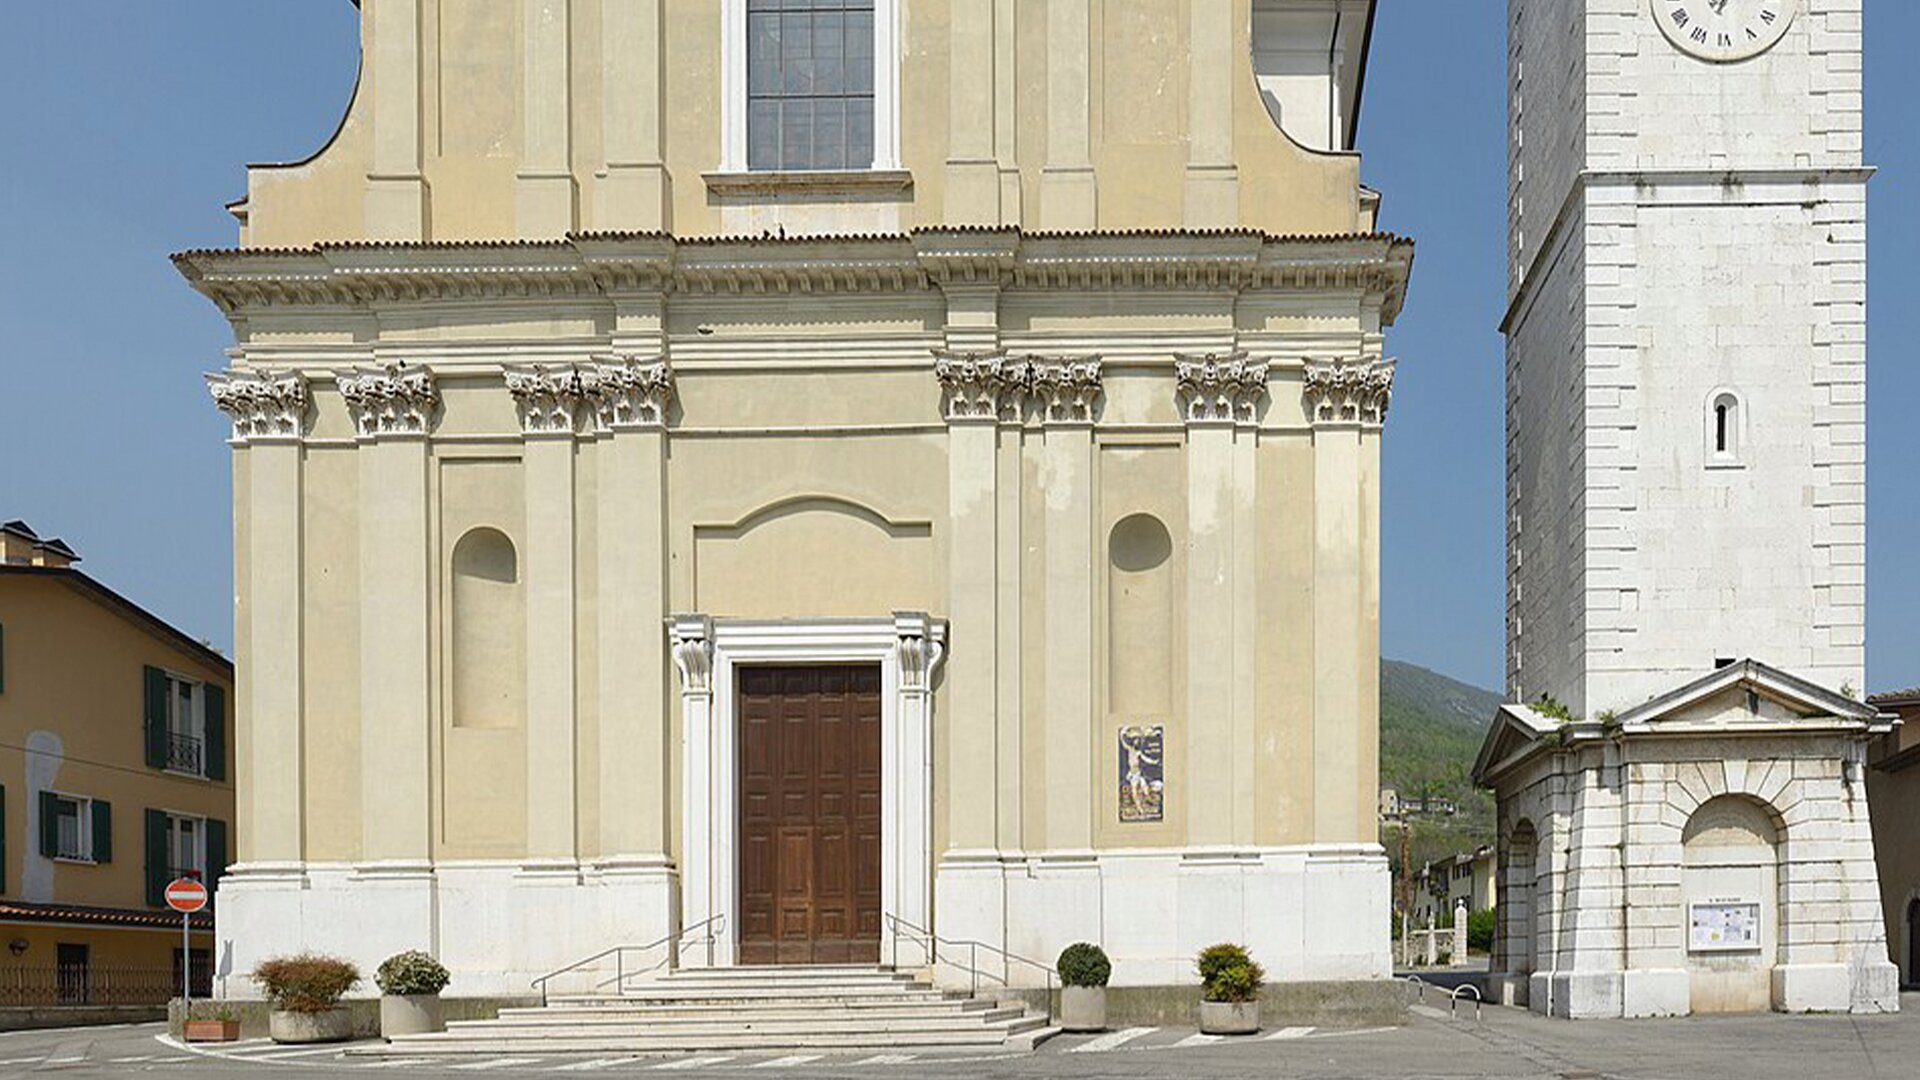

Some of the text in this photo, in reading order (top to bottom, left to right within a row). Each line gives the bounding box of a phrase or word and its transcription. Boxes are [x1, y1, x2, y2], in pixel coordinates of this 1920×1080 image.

[1760, 10, 1776, 26] IV
[1690, 27, 1707, 44] VII
[1717, 33, 1731, 46] VI
[1745, 28, 1757, 40] V
